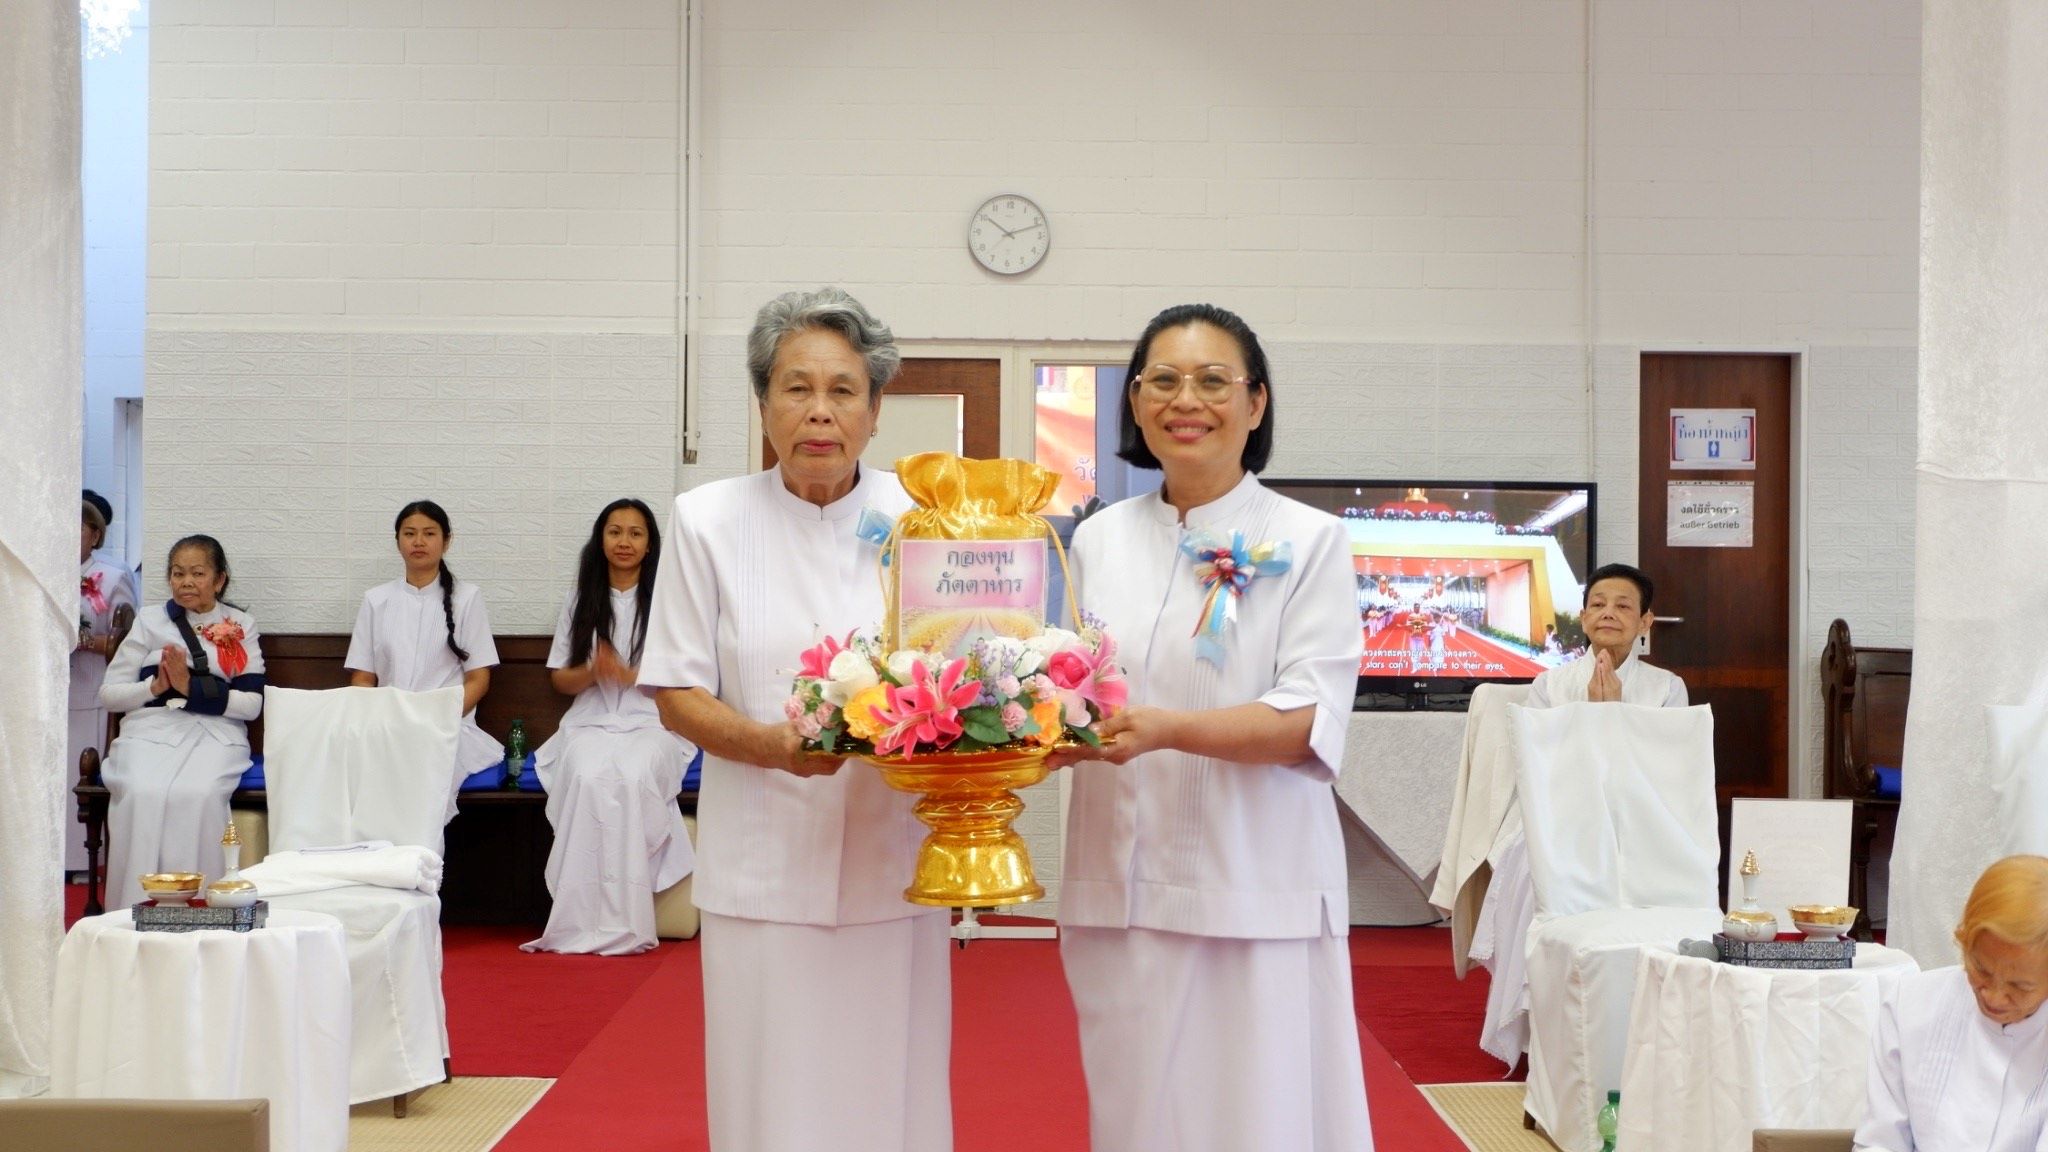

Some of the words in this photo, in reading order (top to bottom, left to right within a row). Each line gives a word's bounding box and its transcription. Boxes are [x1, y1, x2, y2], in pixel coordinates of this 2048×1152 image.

[1006, 201, 1015, 209] 12
[947, 549, 1014, 573] กองทุน
[936, 571, 1023, 594] ภัตตาหาร
[1366, 660, 1385, 669] stars
[1388, 659, 1409, 669] can't
[1451, 661, 1460, 669] to
[1463, 660, 1482, 669] their
